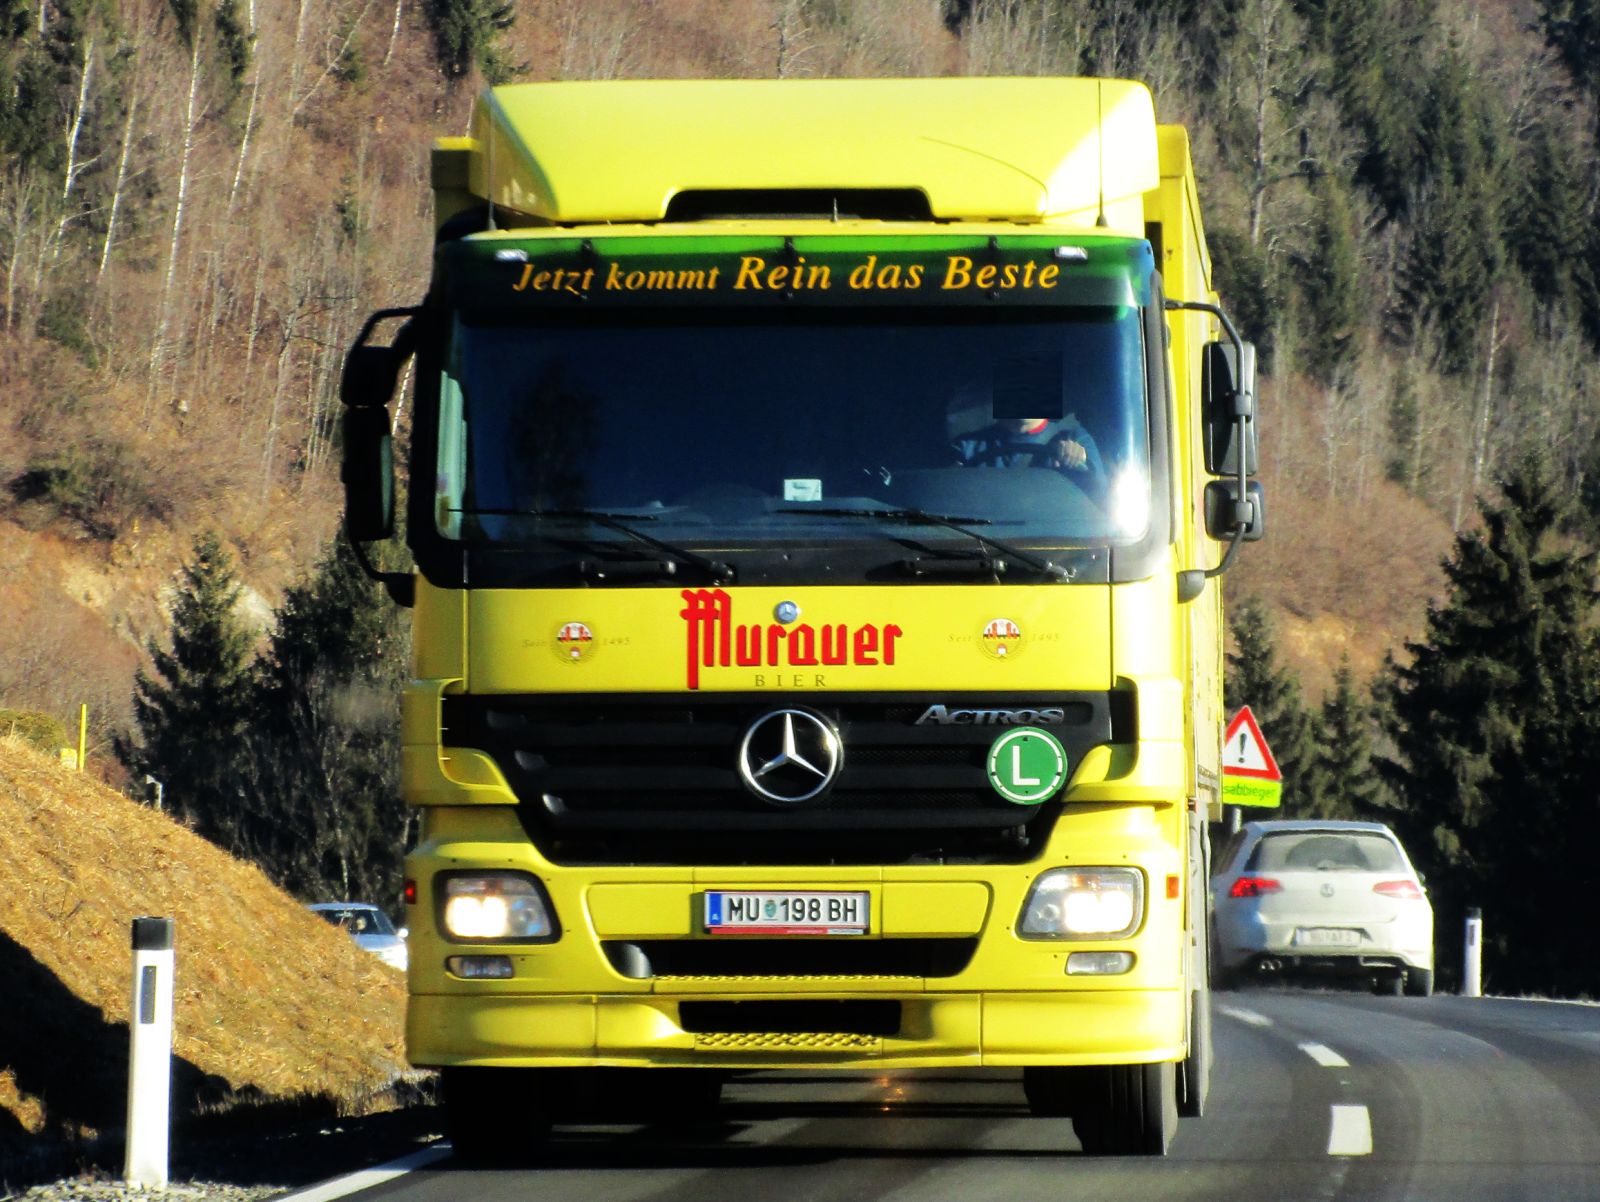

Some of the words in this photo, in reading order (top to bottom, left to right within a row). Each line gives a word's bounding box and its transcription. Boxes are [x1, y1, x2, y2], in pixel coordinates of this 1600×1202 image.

[512, 263, 595, 296] Jetzt
[605, 262, 720, 290] kommt
[733, 256, 832, 290] Rein
[849, 255, 924, 290] das
[941, 255, 1060, 290] Beste
[679, 588, 904, 690] Murauer
[754, 674, 827, 688] BIER
[1012, 745, 1041, 786] L
[728, 898, 760, 922] MU
[779, 898, 822, 922] 198
[828, 898, 858, 922] BH
